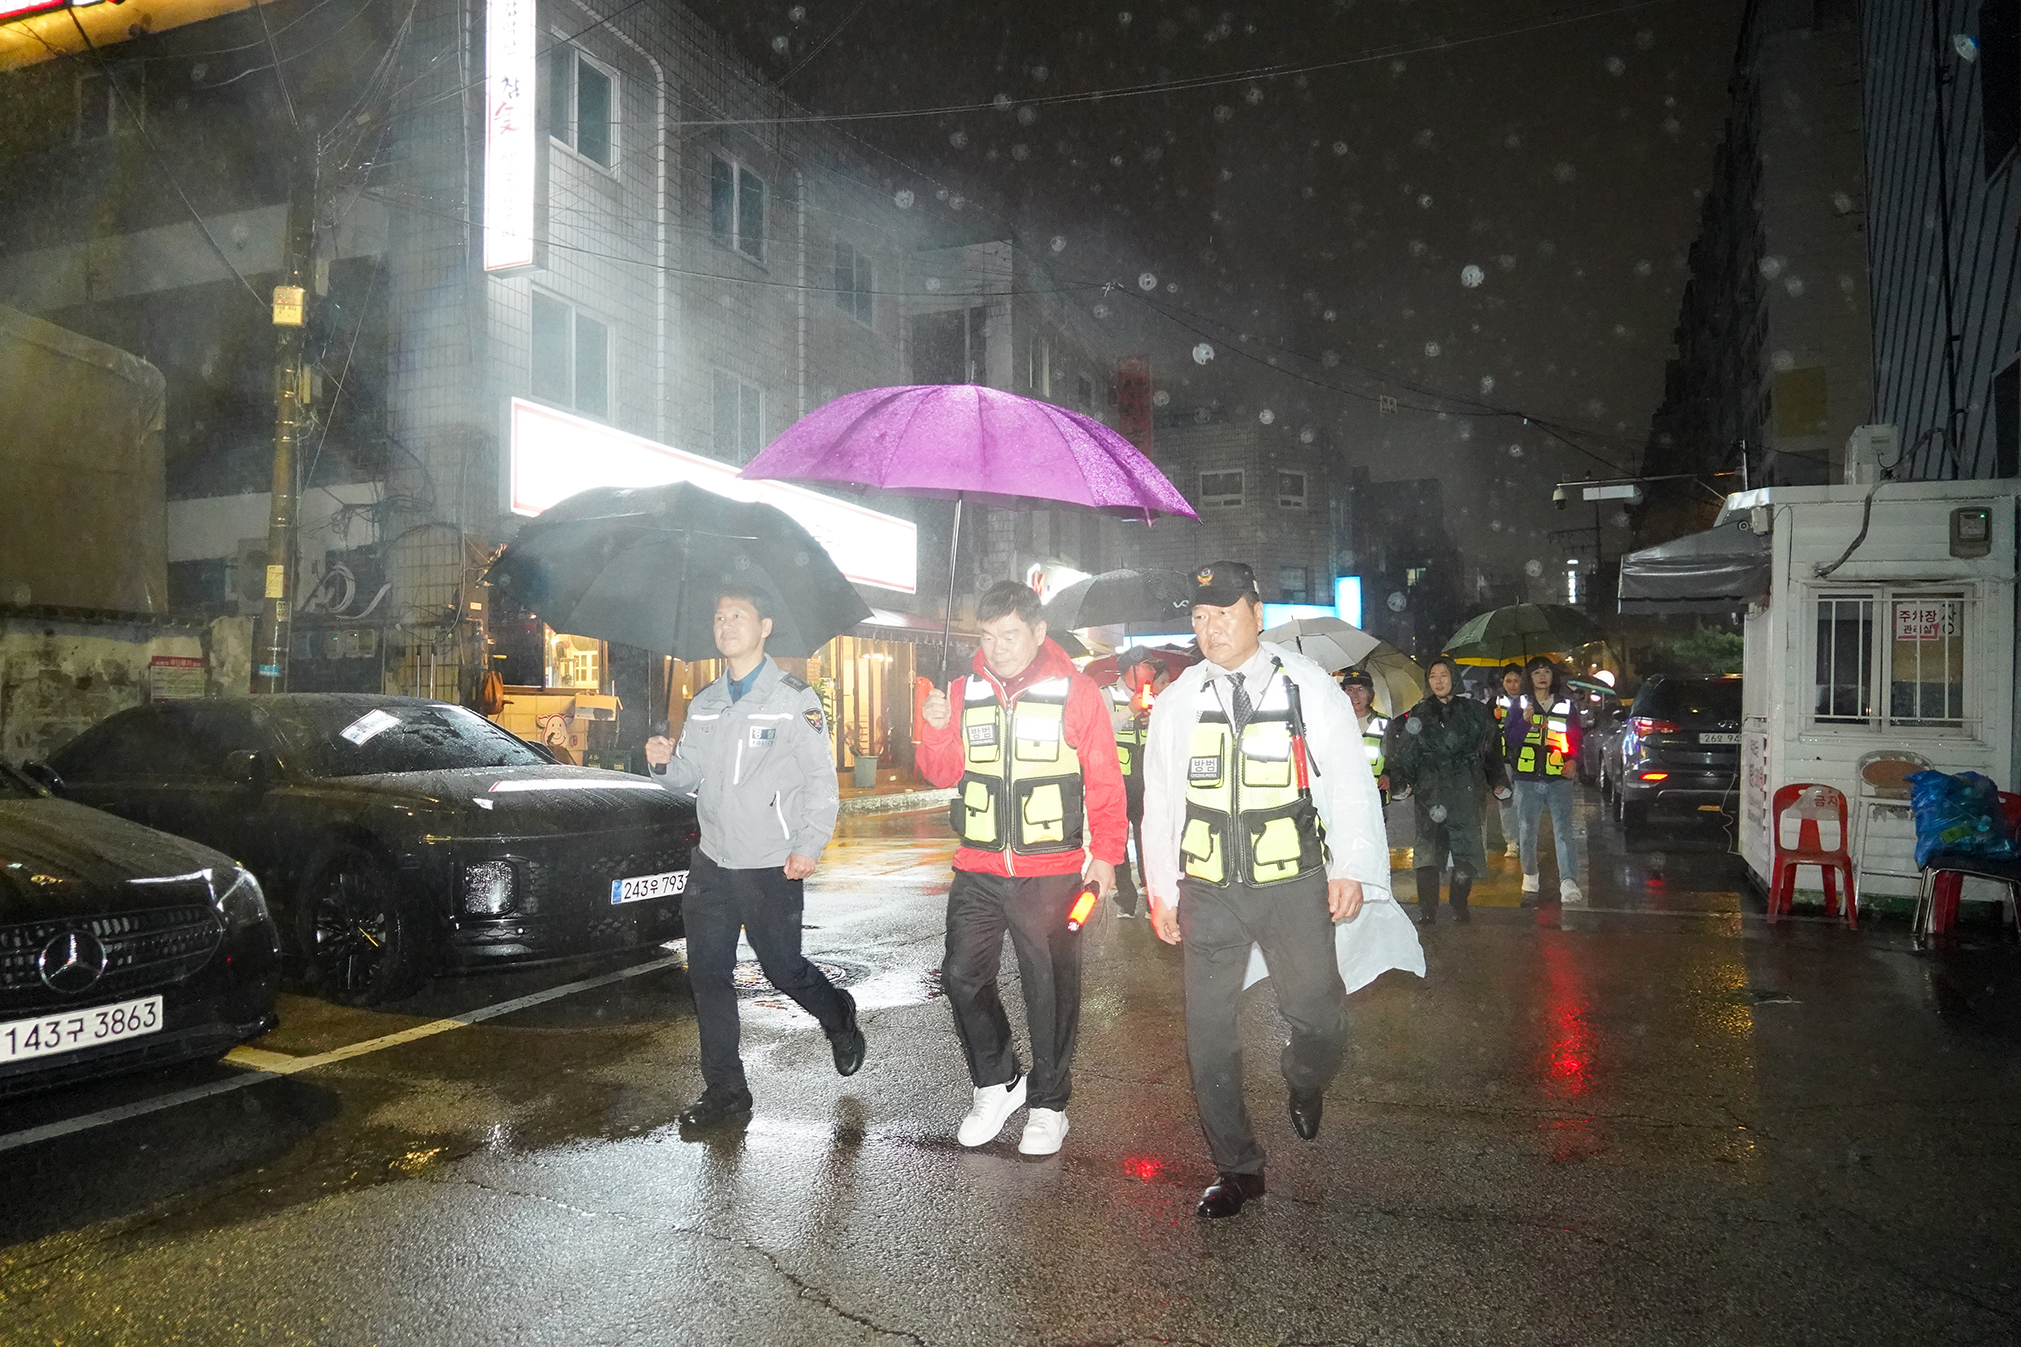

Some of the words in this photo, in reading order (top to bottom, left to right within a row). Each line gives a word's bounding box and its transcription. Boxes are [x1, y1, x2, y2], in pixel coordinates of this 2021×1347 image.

[493, 75, 523, 136] 참숯
[1899, 610, 1937, 623] 주차장
[1903, 624, 1933, 634] 관리실
[971, 726, 991, 739] 방범
[1194, 759, 1216, 773] 방범
[1814, 794, 1838, 808] 금지
[624, 879, 659, 900] 243우
[662, 874, 689, 894] 793
[5, 1017, 84, 1055] 143구
[94, 1001, 157, 1039] 3863
